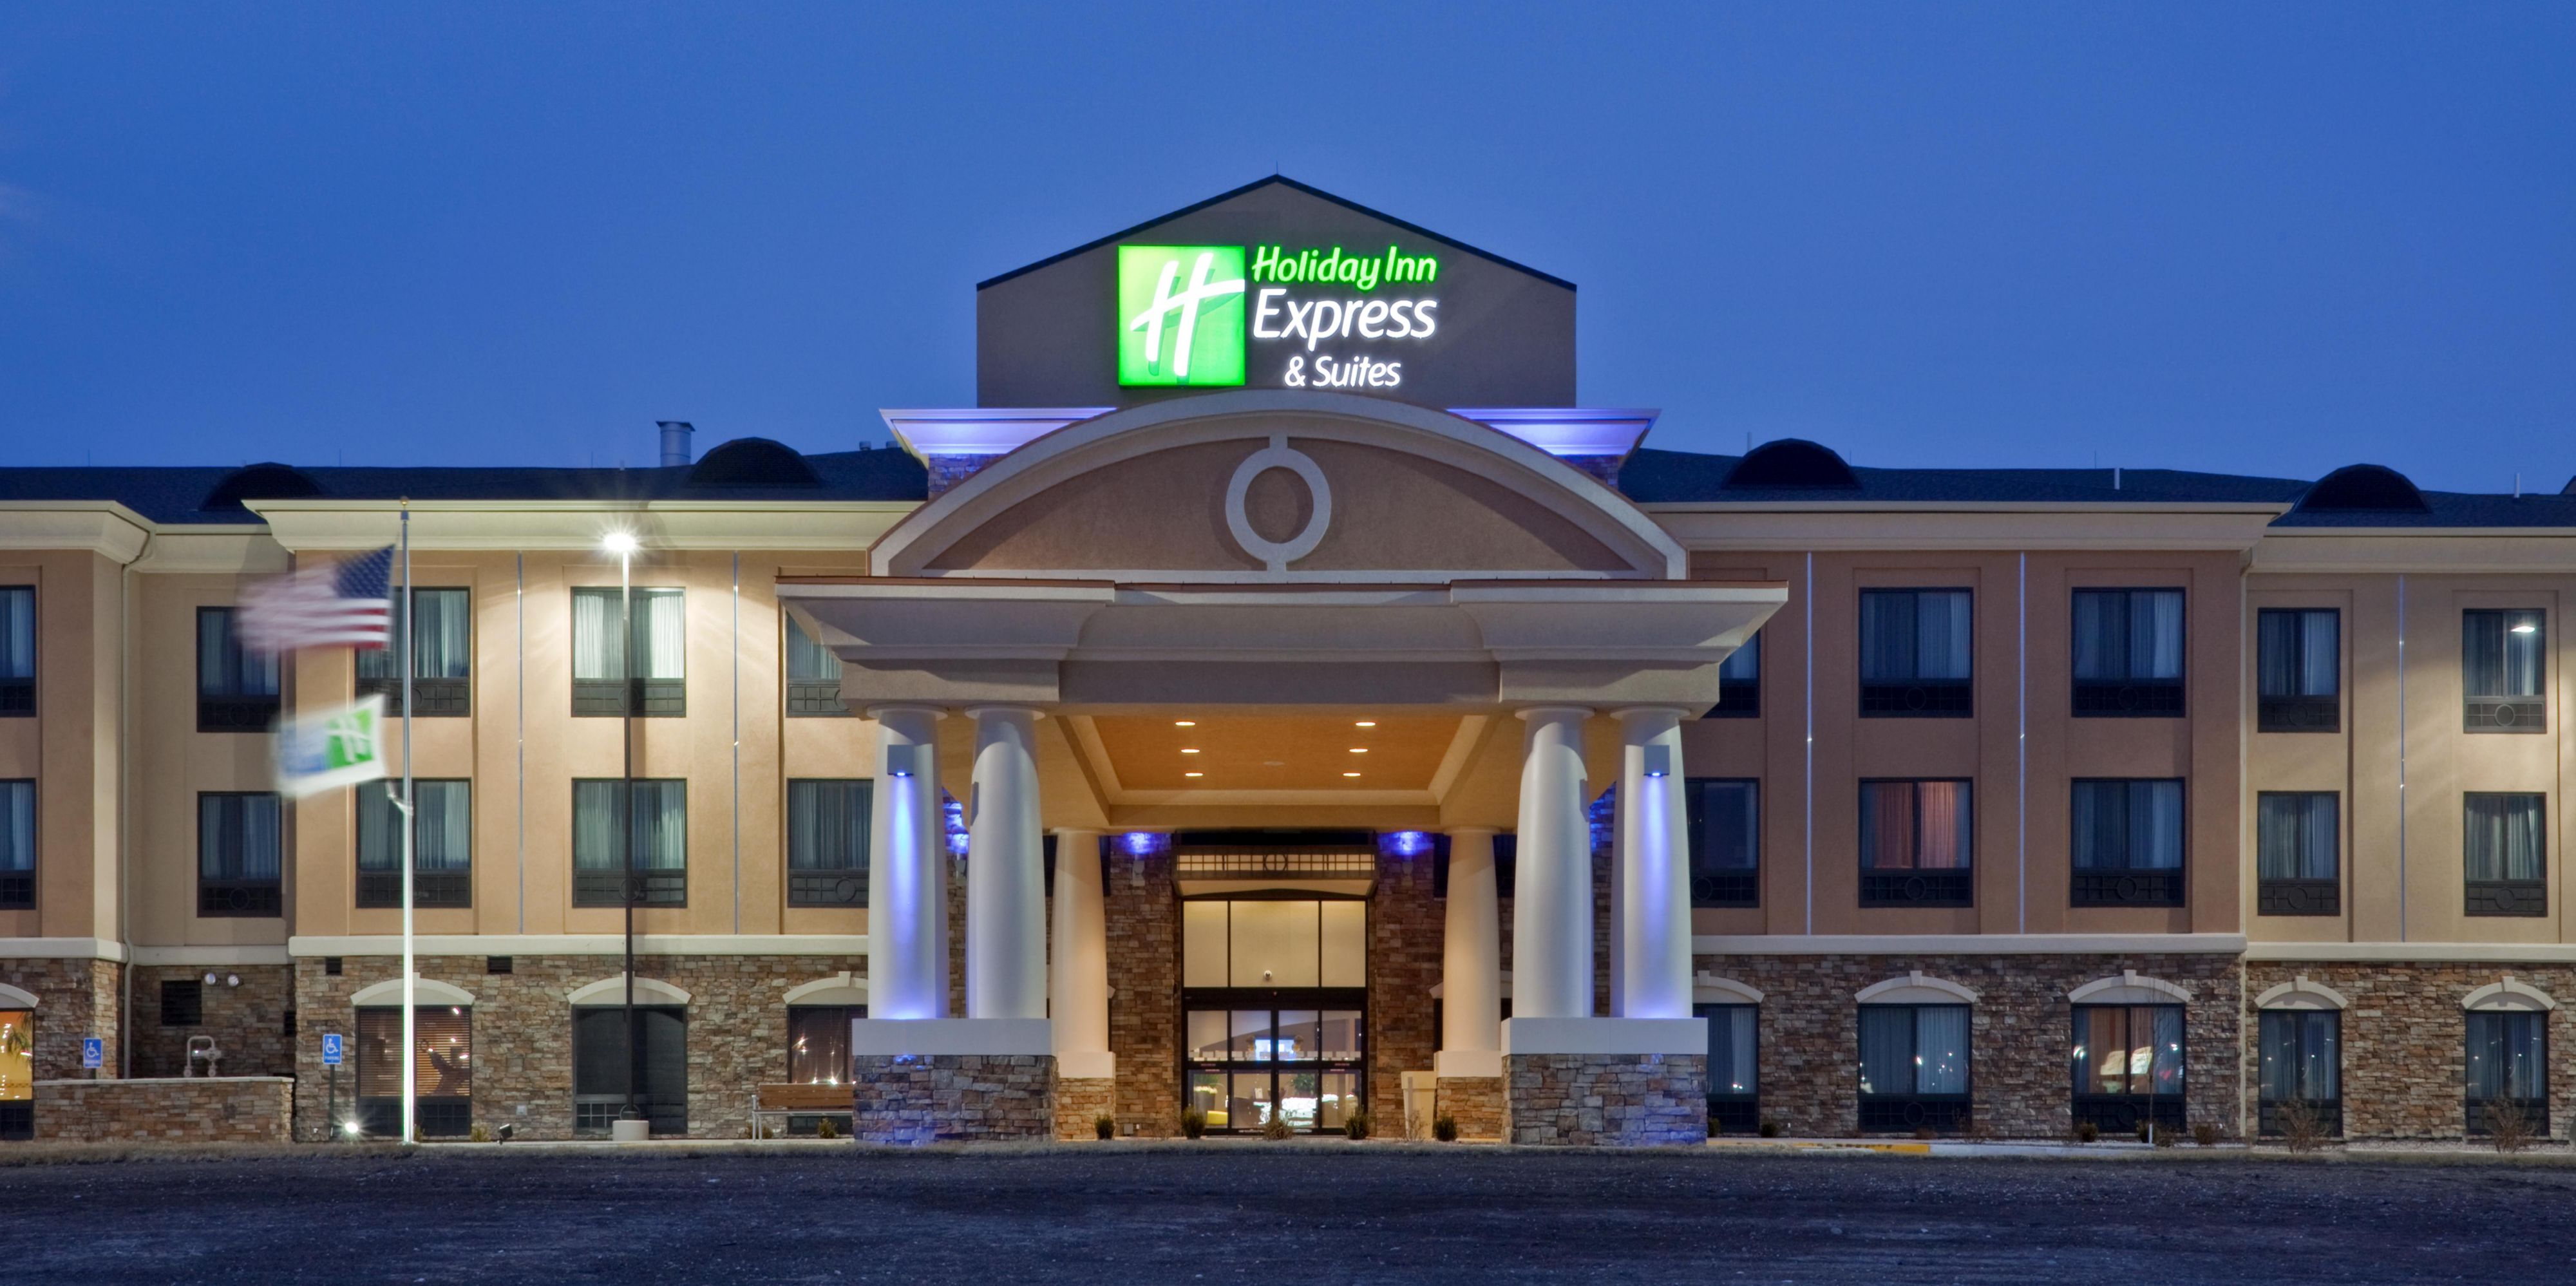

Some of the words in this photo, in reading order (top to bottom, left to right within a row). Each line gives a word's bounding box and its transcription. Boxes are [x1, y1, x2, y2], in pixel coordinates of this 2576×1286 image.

[1252, 245, 1381, 290] Holiday
[1385, 245, 1437, 282] Inn
[1130, 252, 1245, 377] H
[1253, 288, 1437, 352] Express
[1284, 355, 1306, 386] &
[1312, 355, 1401, 388] Suites
